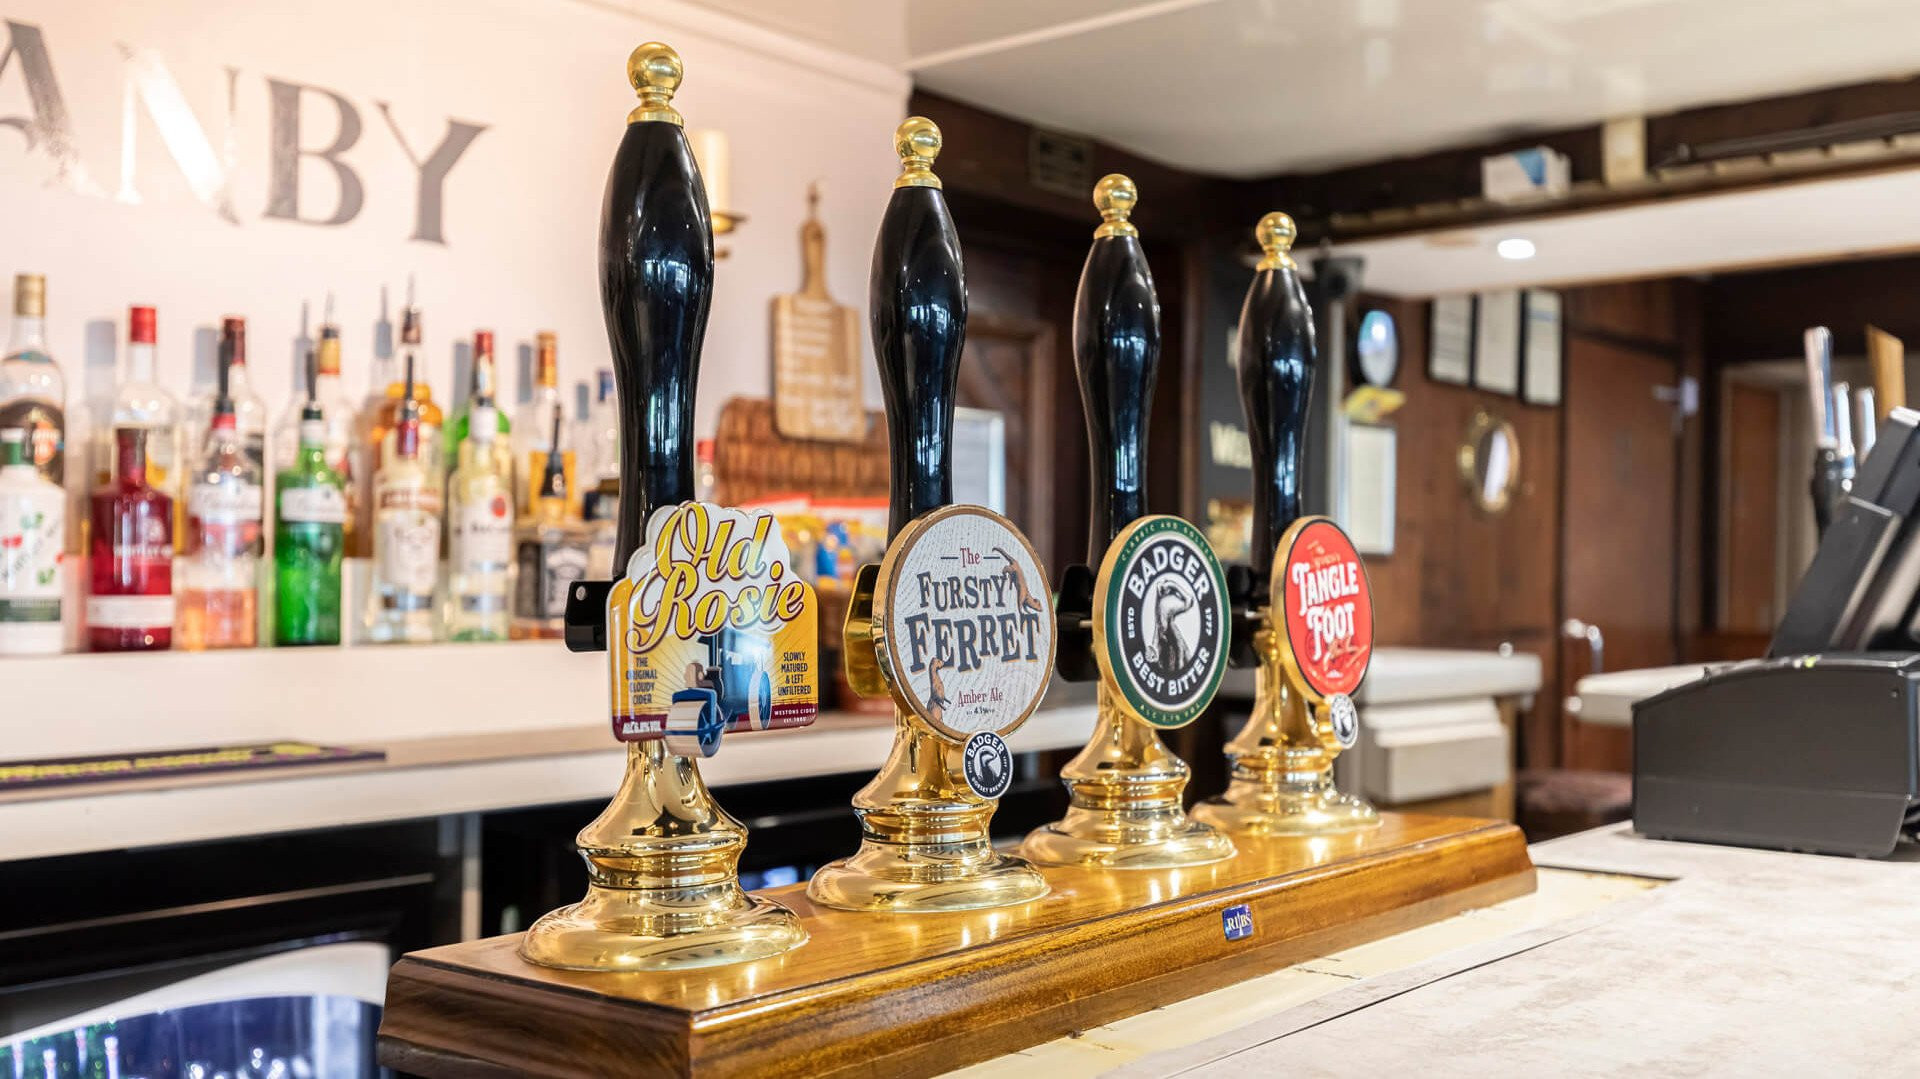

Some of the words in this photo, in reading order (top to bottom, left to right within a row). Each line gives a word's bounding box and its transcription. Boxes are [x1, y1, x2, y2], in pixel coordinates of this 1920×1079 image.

[1161, 522, 1178, 530] AND
[656, 500, 774, 582] Old
[959, 547, 981, 568] The
[1128, 545, 1210, 601] BADGER
[917, 571, 1008, 612] FURSTY
[1292, 562, 1359, 617] TANGLE
[626, 560, 805, 654] Rosie
[1307, 602, 1355, 661] FOOT
[904, 612, 1040, 674] FERRET
[636, 657, 648, 667] THE
[783, 652, 806, 662] SLOWLY
[626, 669, 657, 680] ORIGINAL
[781, 663, 808, 673] MATURED
[1132, 651, 1165, 693] BEST
[1168, 646, 1210, 696] BITTER
[630, 682, 655, 692] CLOUDY
[792, 674, 804, 684] LEFT
[633, 694, 652, 704] CIDER
[778, 685, 811, 696] UNFILTERED
[958, 689, 987, 708] Amber
[990, 687, 1003, 701] Ale
[967, 734, 1005, 758] BADGER
